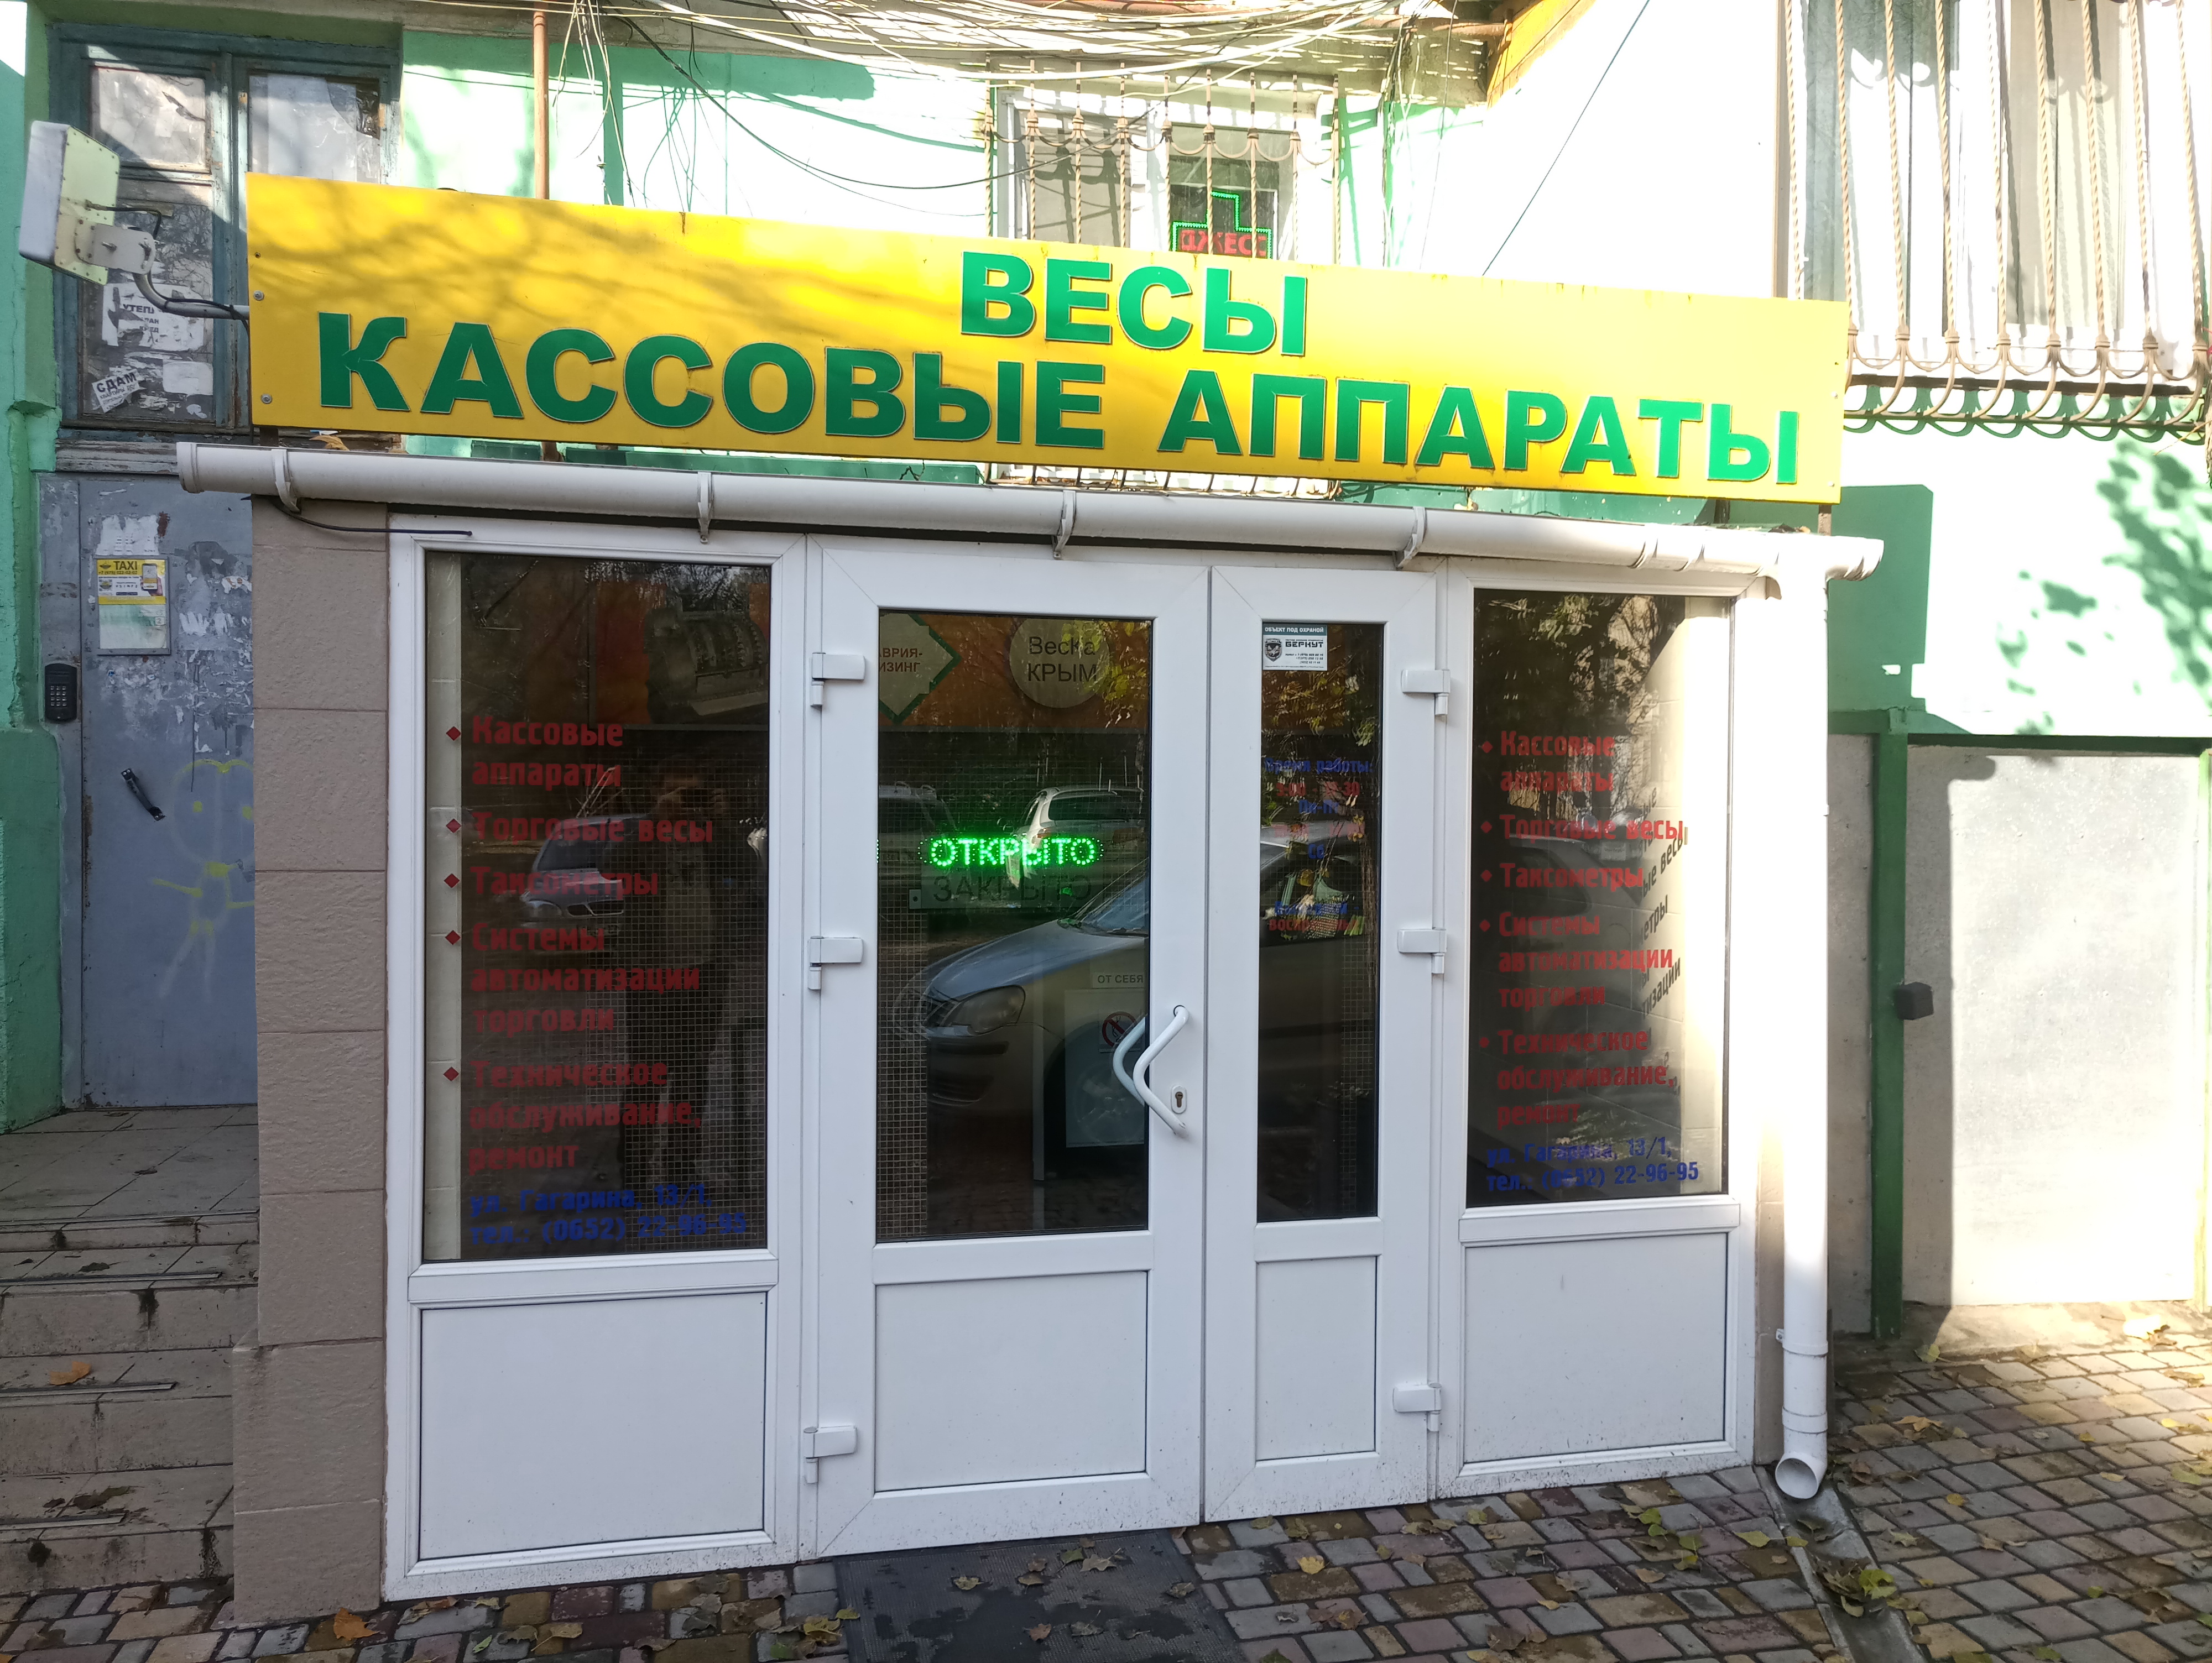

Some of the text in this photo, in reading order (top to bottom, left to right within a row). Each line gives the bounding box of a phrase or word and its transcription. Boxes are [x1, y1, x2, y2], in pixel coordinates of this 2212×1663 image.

[961, 251, 1307, 357] ВЕСЫ
[96, 372, 137, 393] СДАМ
[318, 312, 1799, 485] КАССОВЫЕ АППАРАТЫ
[113, 561, 137, 570] TAXI
[880, 647, 923, 658] ВРИЯ-
[1028, 663, 1097, 682] КРЫМ
[472, 716, 623, 746] Кассовые
[1500, 730, 1615, 757] Кассовые
[472, 761, 622, 791] аппараты
[1500, 771, 1614, 794] аппараты
[471, 812, 713, 845] Торговые весы
[1499, 814, 1616, 844] Торговые
[1626, 820, 1683, 840] весы
[930, 838, 1096, 866] ОТКРЫТО
[470, 866, 658, 900] Таксометры
[1499, 863, 1644, 892] Таксометры
[472, 923, 605, 951] Системы
[1499, 912, 1600, 937] Системы
[1499, 949, 1673, 972] автоматизации
[471, 968, 700, 994] автоматизации
[1097, 975, 1144, 984] ОТ СЕБЯ
[1499, 986, 1605, 1012] торговли
[473, 1008, 614, 1038] торговли
[1498, 1029, 1647, 1055] Техническое
[470, 1061, 667, 1088] Техническое
[1498, 1065, 1674, 1093] обслуживание,
[469, 1101, 701, 1133] обслуживание,
[1497, 1104, 1580, 1130] ремонт
[468, 1145, 579, 1175] ремонт
[1486, 1148, 1515, 1168] ул.
[1542, 1167, 1605, 1189] (0652)
[1614, 1162, 1699, 1185] 22-96-95
[470, 1195, 507, 1217] ул.
[520, 1189, 643, 1212] Гагарина,
[542, 1217, 625, 1244] (0652)
[637, 1212, 747, 1238] 22-96-95
